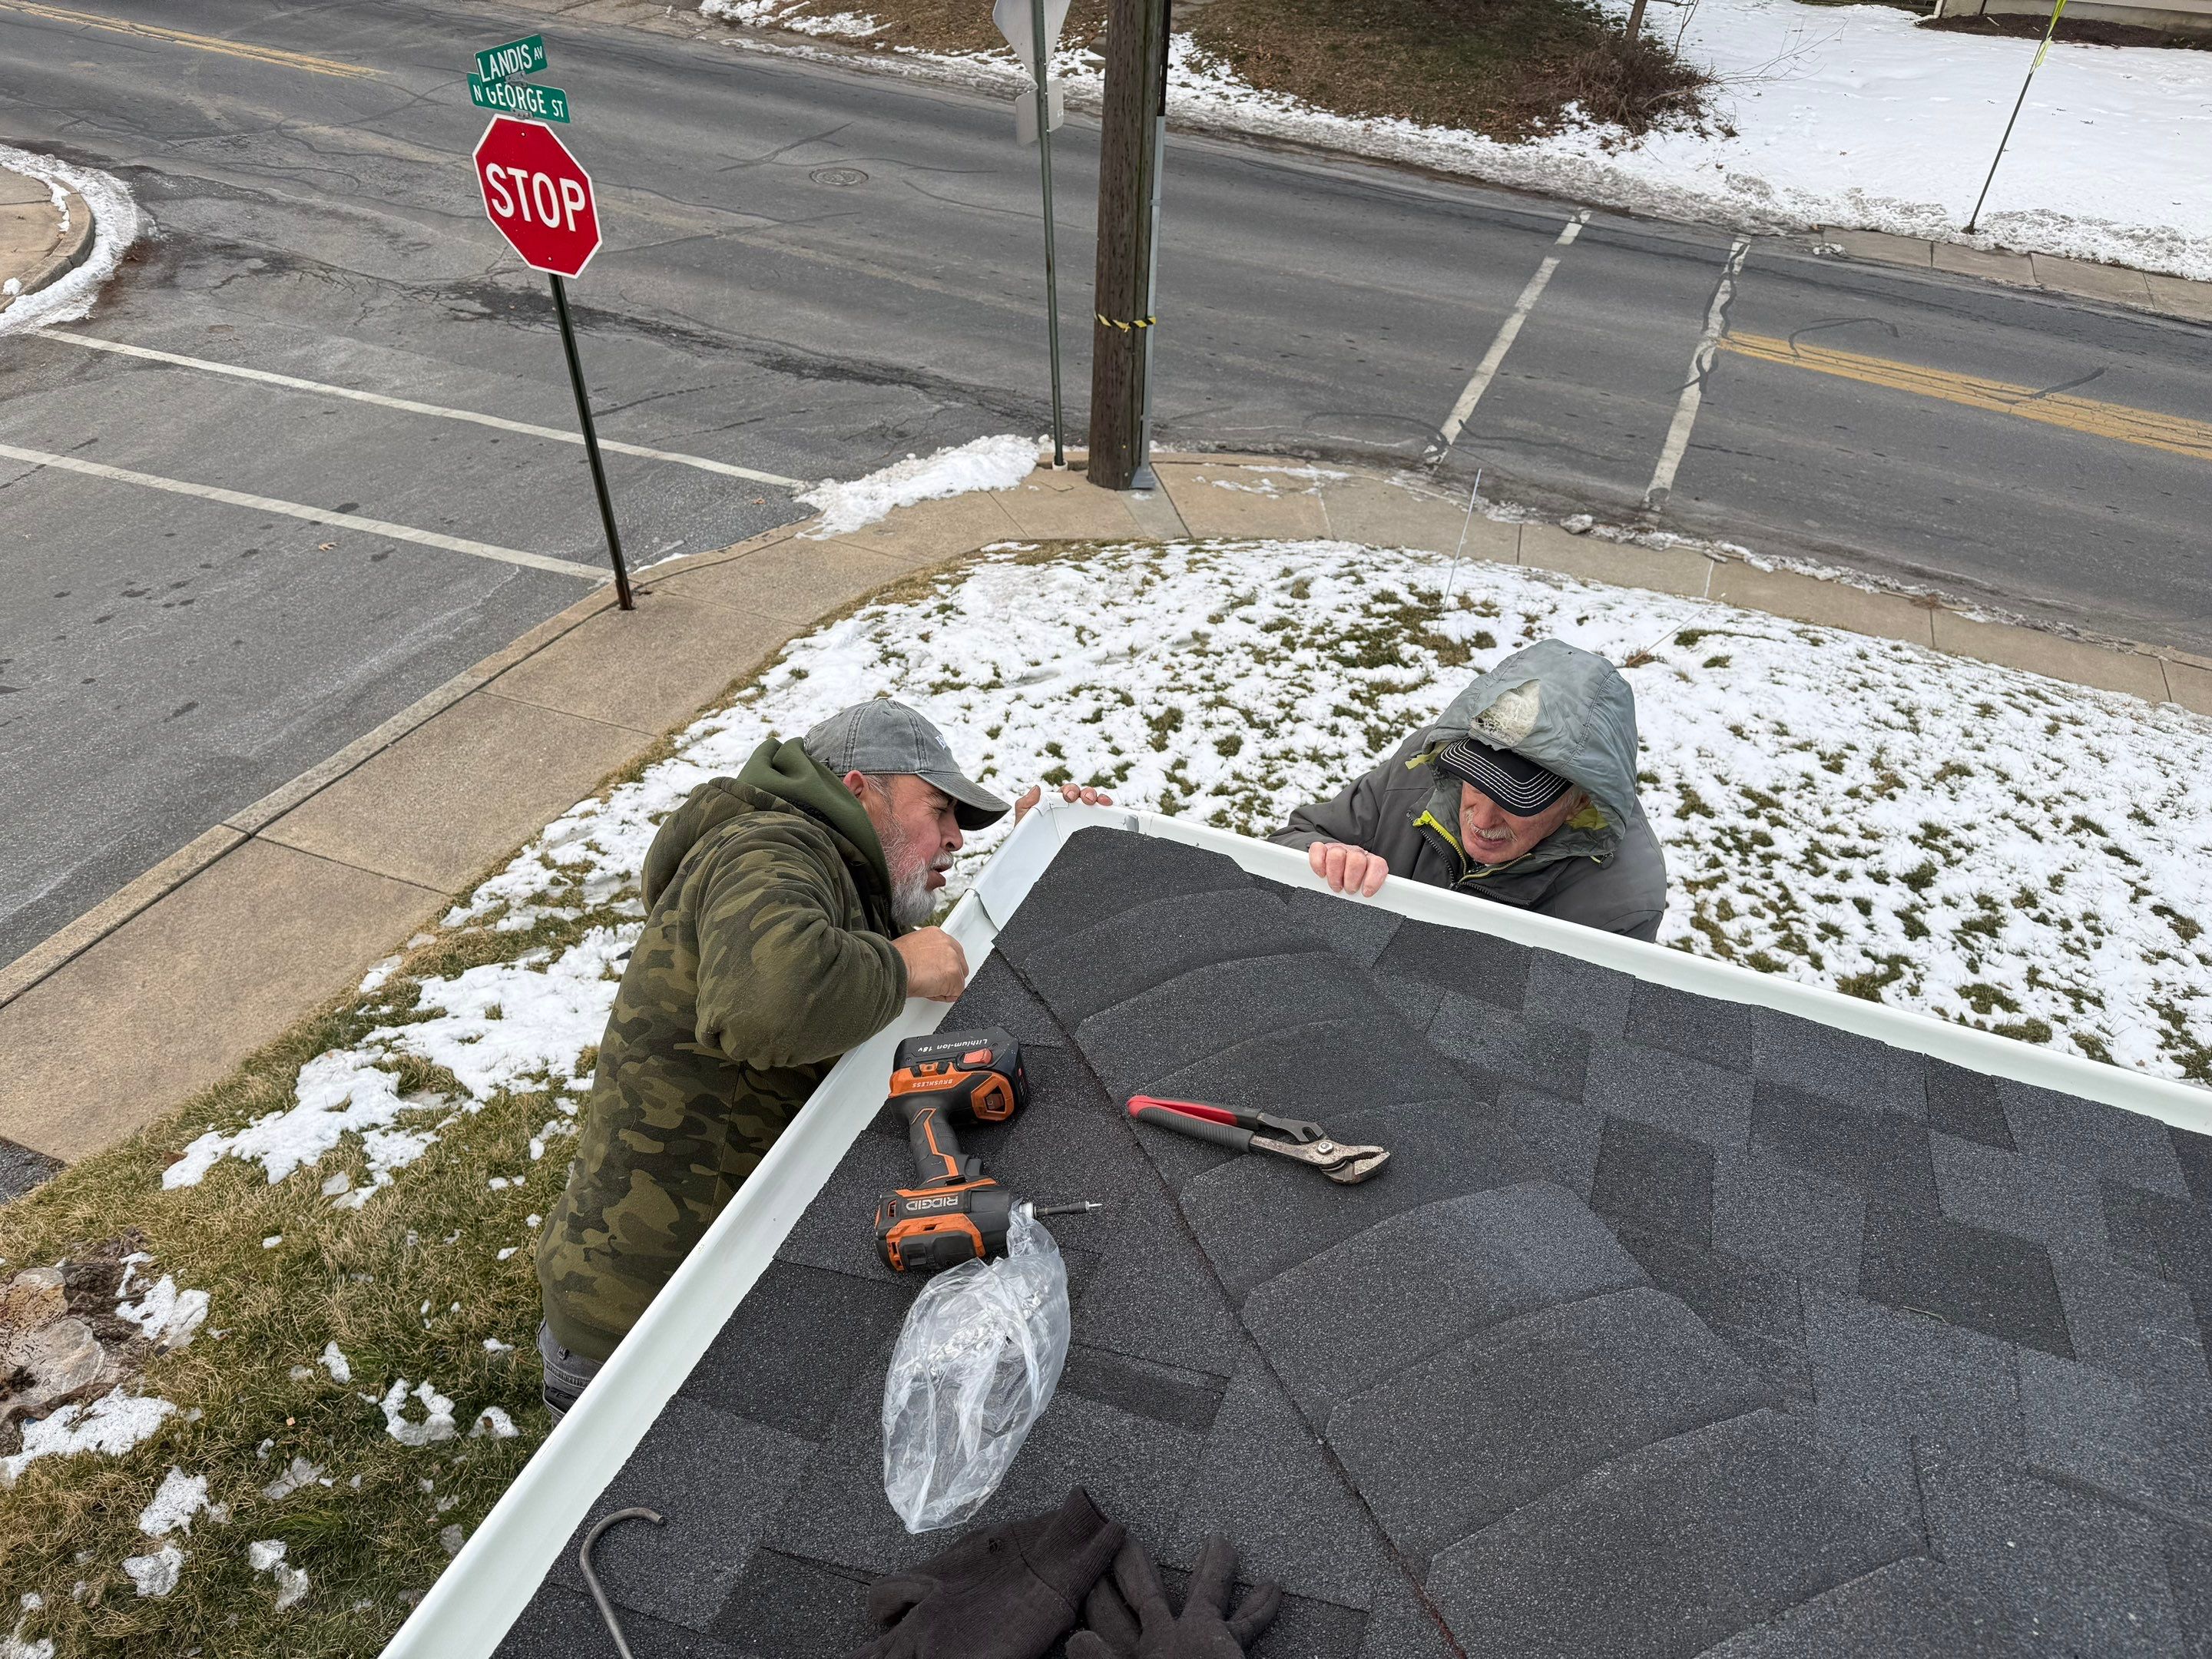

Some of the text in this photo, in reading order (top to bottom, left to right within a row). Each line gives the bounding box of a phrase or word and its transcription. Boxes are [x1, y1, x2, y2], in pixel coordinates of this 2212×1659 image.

[477, 44, 542, 82] LANDIS AV
[472, 84, 563, 118] N GEORGE ST
[485, 163, 586, 232] STOP
[912, 1078, 953, 1088] BRUSHLESS
[906, 1196, 959, 1211] RIDGID
